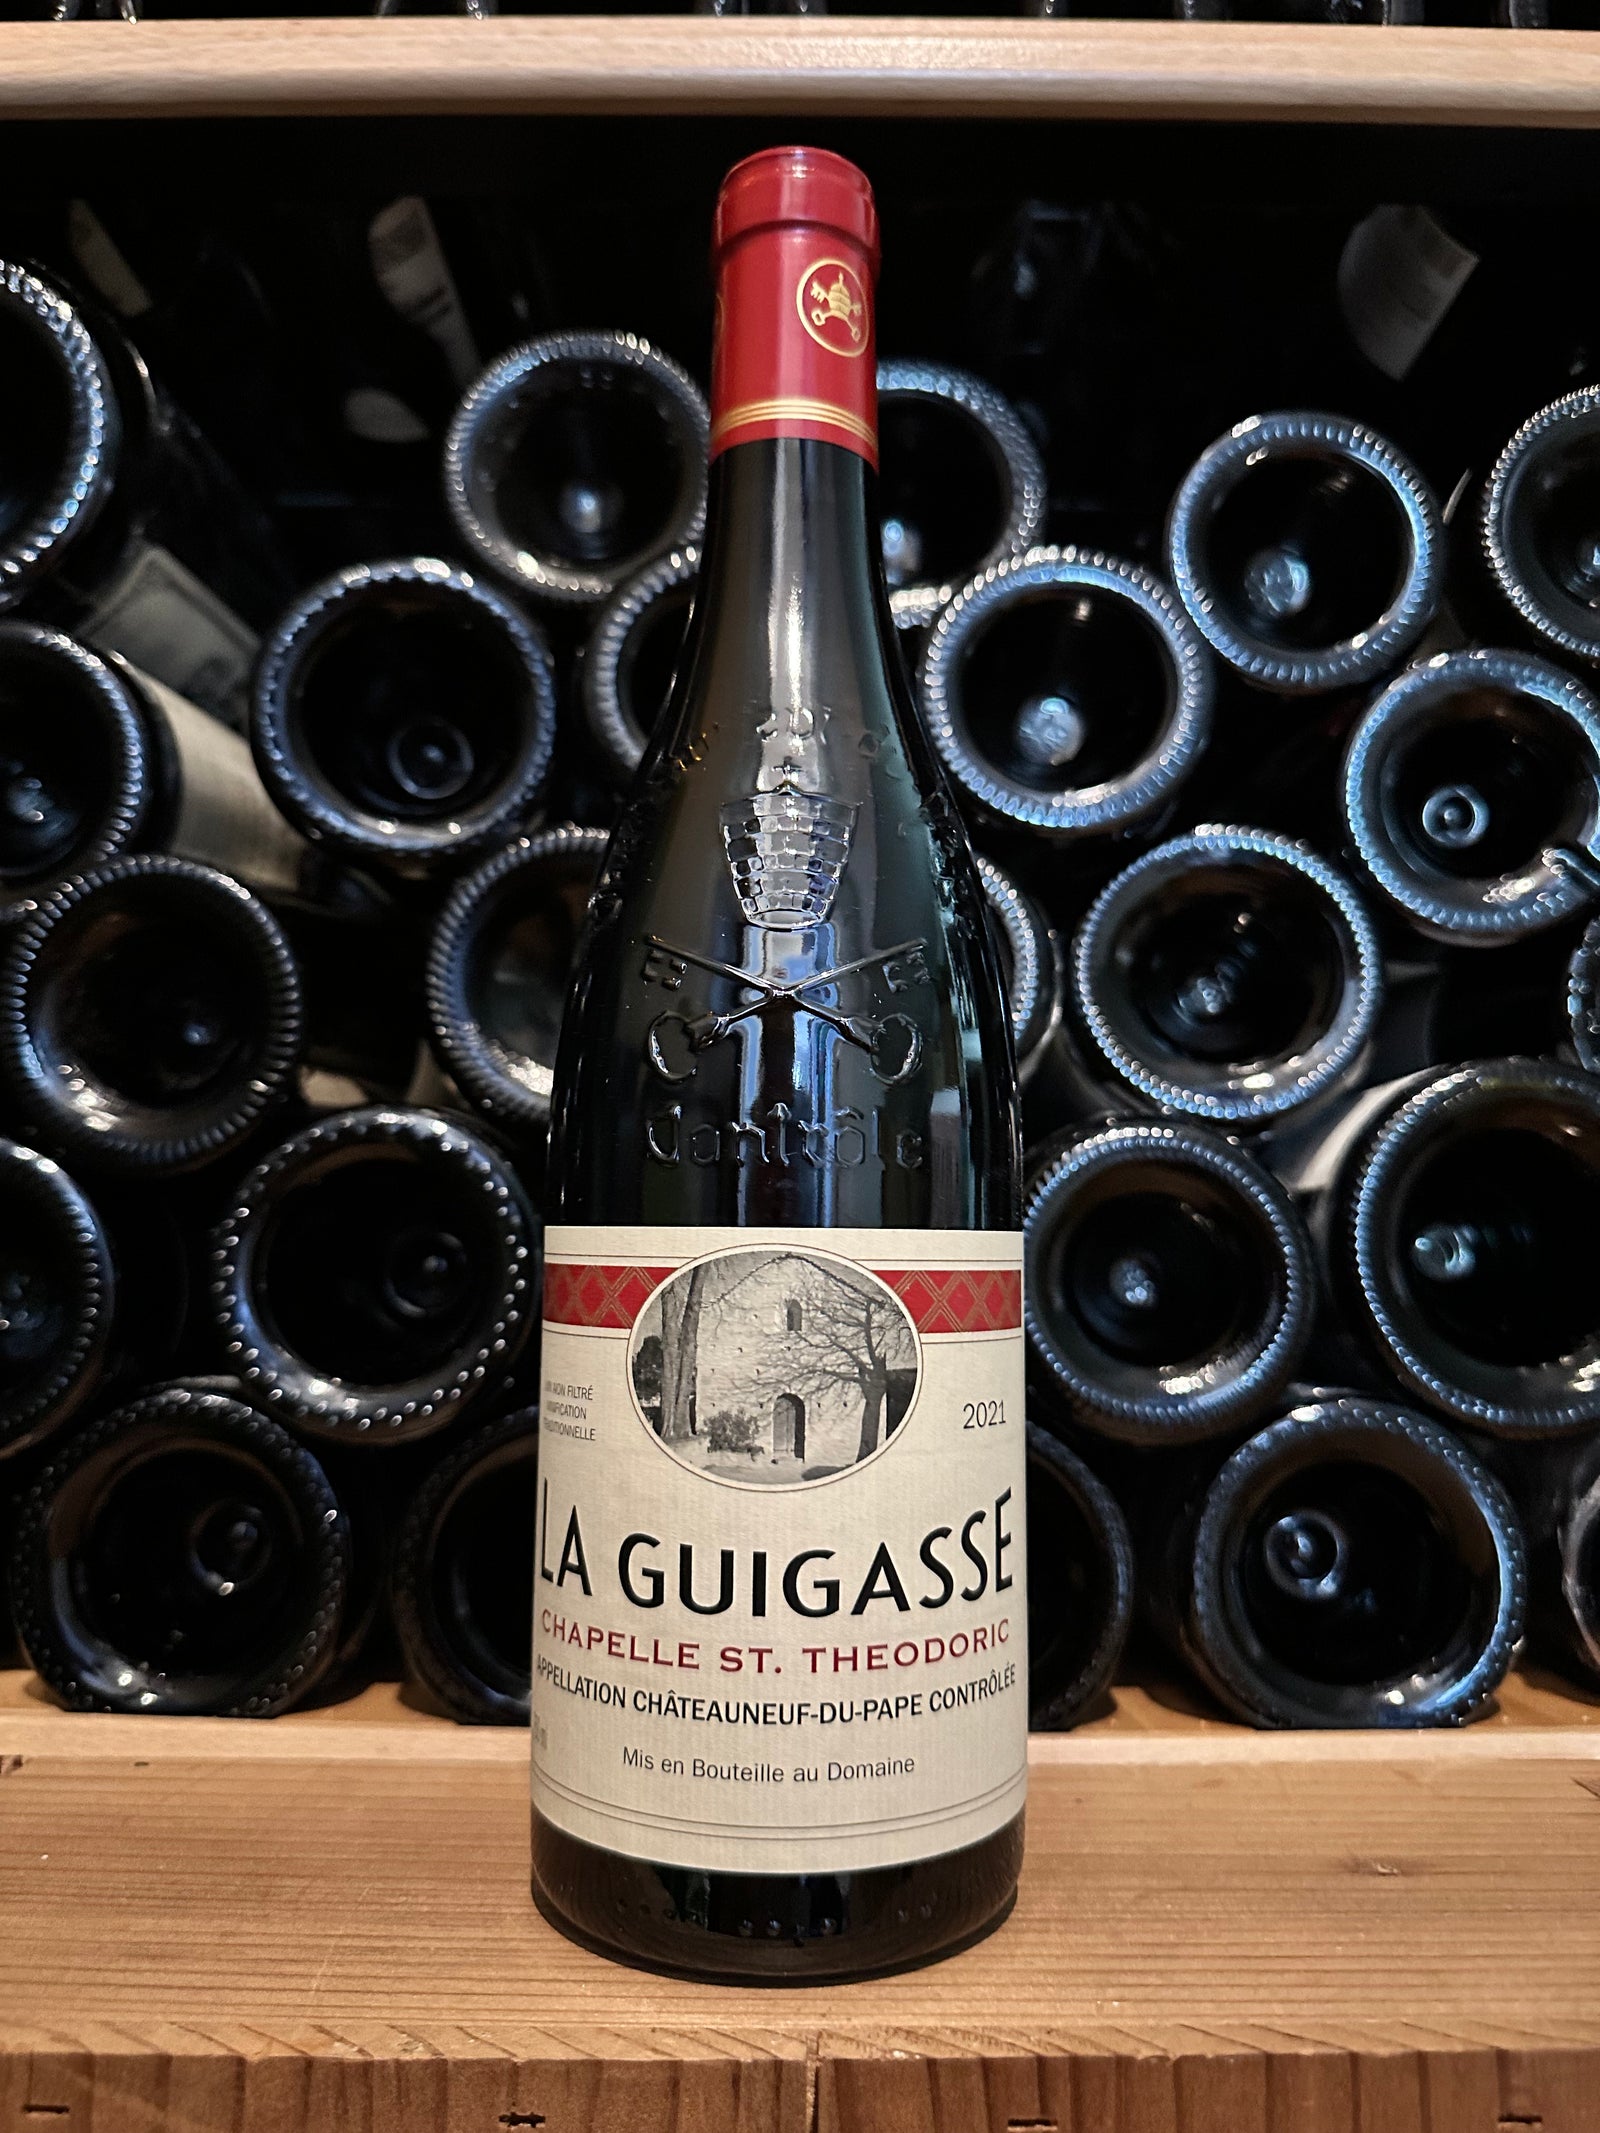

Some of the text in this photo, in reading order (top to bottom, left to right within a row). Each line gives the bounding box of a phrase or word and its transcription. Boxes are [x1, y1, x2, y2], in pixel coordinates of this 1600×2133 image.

[567, 1385, 593, 1401] FILTRÉ
[963, 1399, 1006, 1429] 2021
[541, 1477, 1013, 1619] LA GUIGASSE
[542, 1608, 1009, 1674] CHAPELLE ST. THEODORIC
[537, 1654, 1016, 1726] APPELLATION CHÂTEAUNEUF-DU-PAPE CONTRÔLÉE
[623, 1746, 915, 1783] Mis en Bouteille au Domaine
